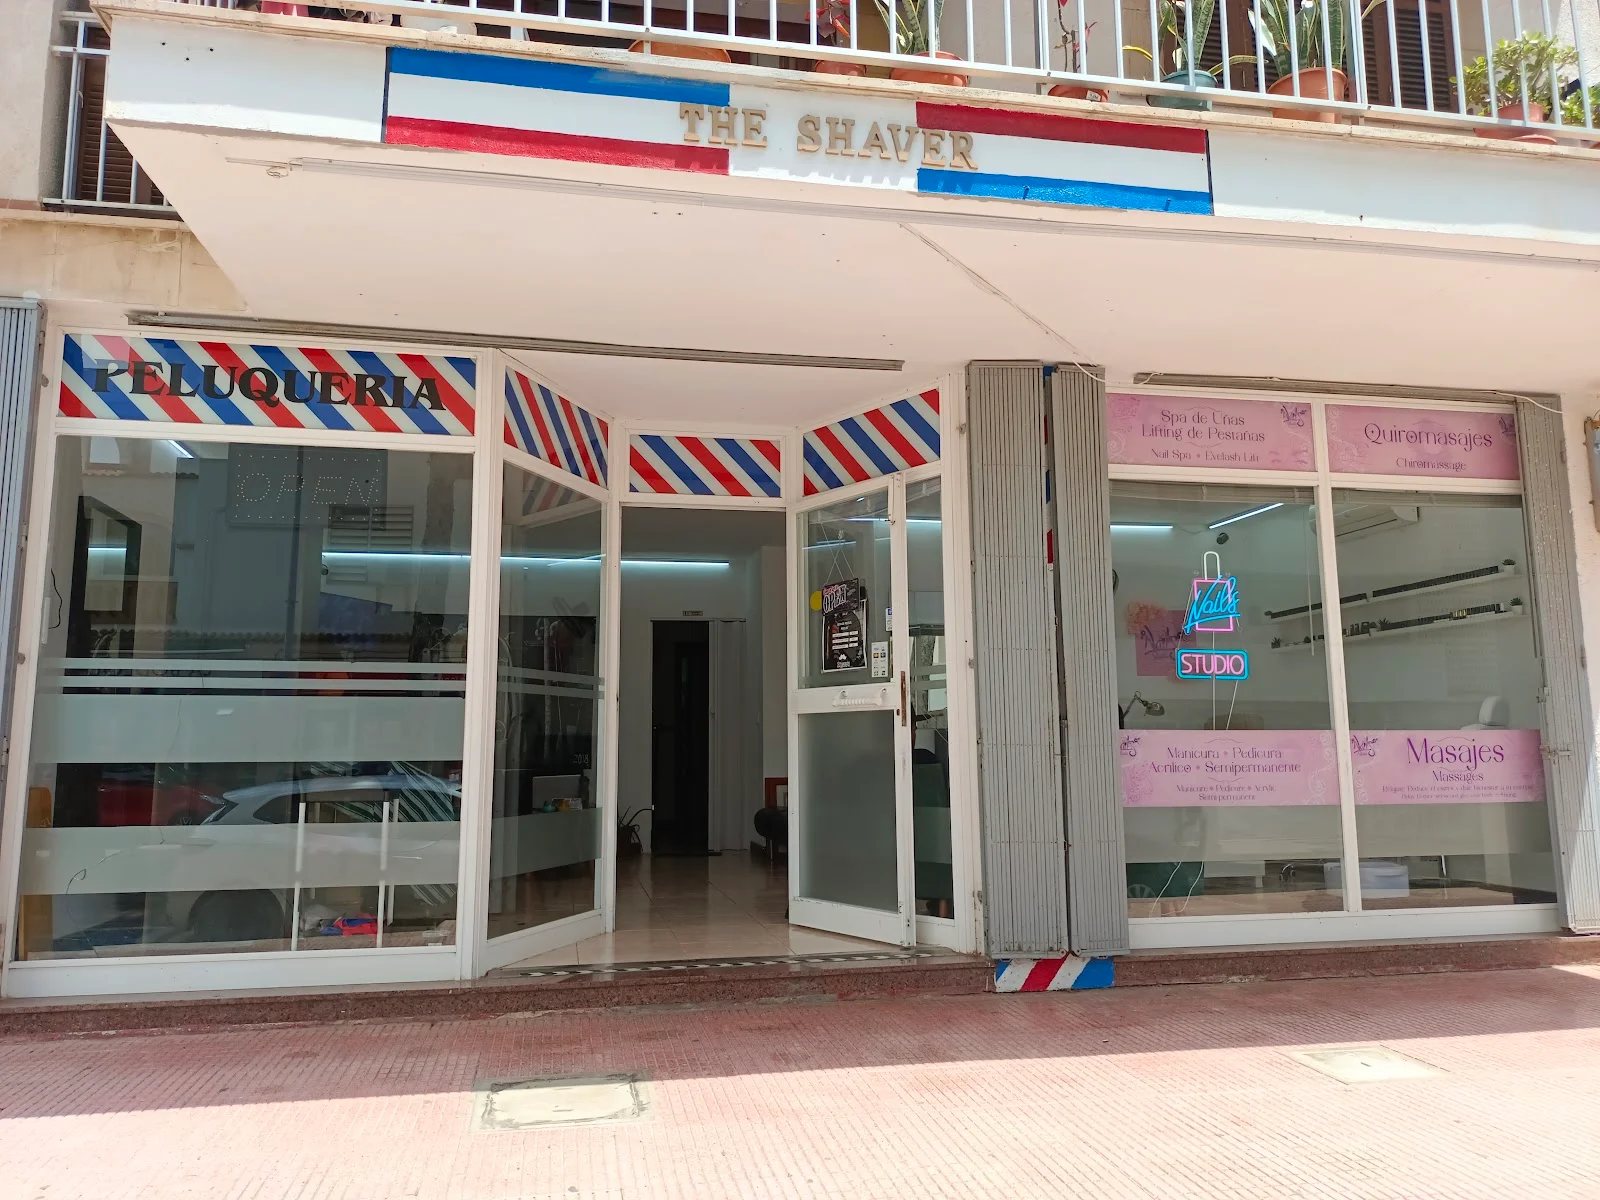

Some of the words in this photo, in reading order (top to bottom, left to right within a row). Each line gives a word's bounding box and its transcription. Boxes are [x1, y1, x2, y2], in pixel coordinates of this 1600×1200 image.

[679, 102, 768, 148] THE
[796, 113, 979, 170] SHAVER
[92, 358, 447, 411] PELUQUERIA
[1161, 409, 1187, 424] Spa
[1192, 411, 1208, 424] de
[1212, 411, 1245, 426] Uñas
[1141, 424, 1182, 441] Lifting
[1187, 426, 1203, 439] de
[1208, 427, 1265, 442] Pestañas
[1364, 422, 1493, 452] Quiromasajes
[1151, 448, 1169, 459] Nail
[1172, 449, 1192, 461] Spa
[1395, 457, 1467, 472] Chiromassage
[240, 472, 376, 506] OPEN
[1183, 575, 1240, 634] Nails
[1181, 653, 1245, 675] STUDIO
[1167, 747, 1220, 759] Manicura
[1232, 747, 1283, 759] Pedicura
[1406, 737, 1505, 771] Masajes
[1205, 761, 1301, 776] Semipermanente
[1432, 770, 1484, 784] Massages
